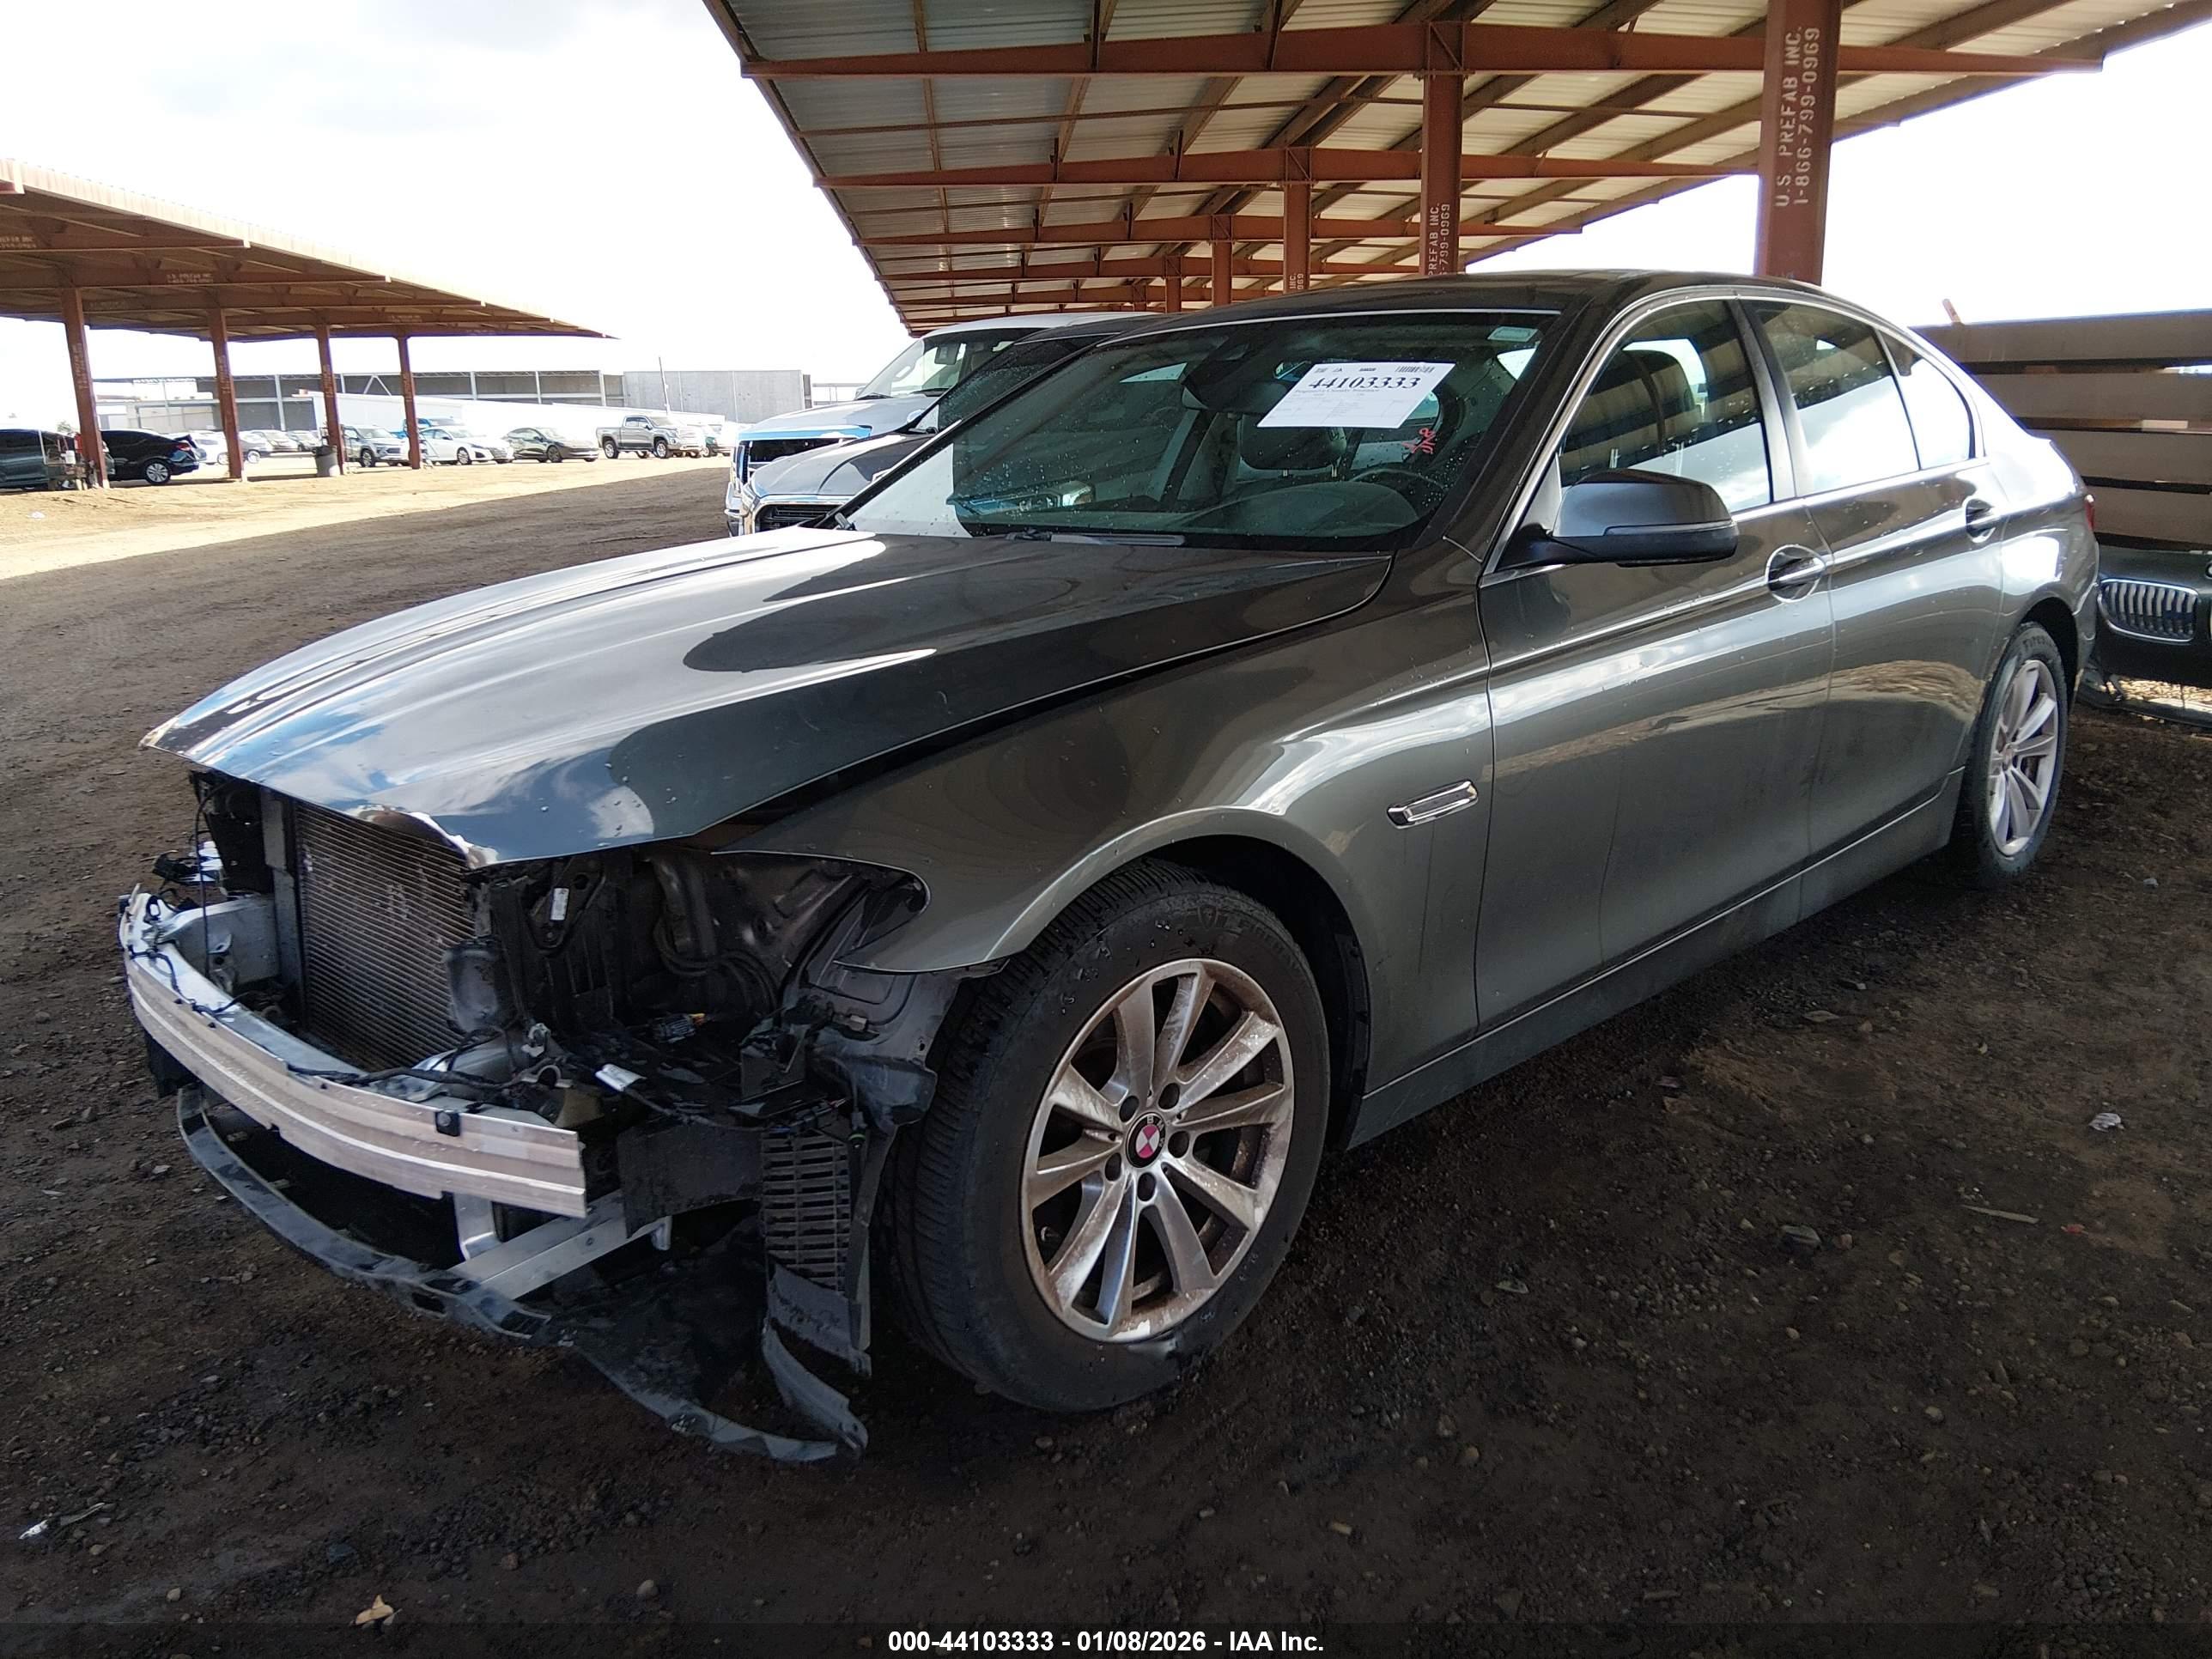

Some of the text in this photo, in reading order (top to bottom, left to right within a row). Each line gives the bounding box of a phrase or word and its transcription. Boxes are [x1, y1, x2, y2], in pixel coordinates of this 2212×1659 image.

[1784, 25, 1802, 65] INC.
[1778, 76, 1798, 157] PREFAB
[1794, 27, 1820, 204] 1-866-799-0969
[1429, 202, 1440, 226] INC.
[1308, 376, 1422, 389] 44103333
